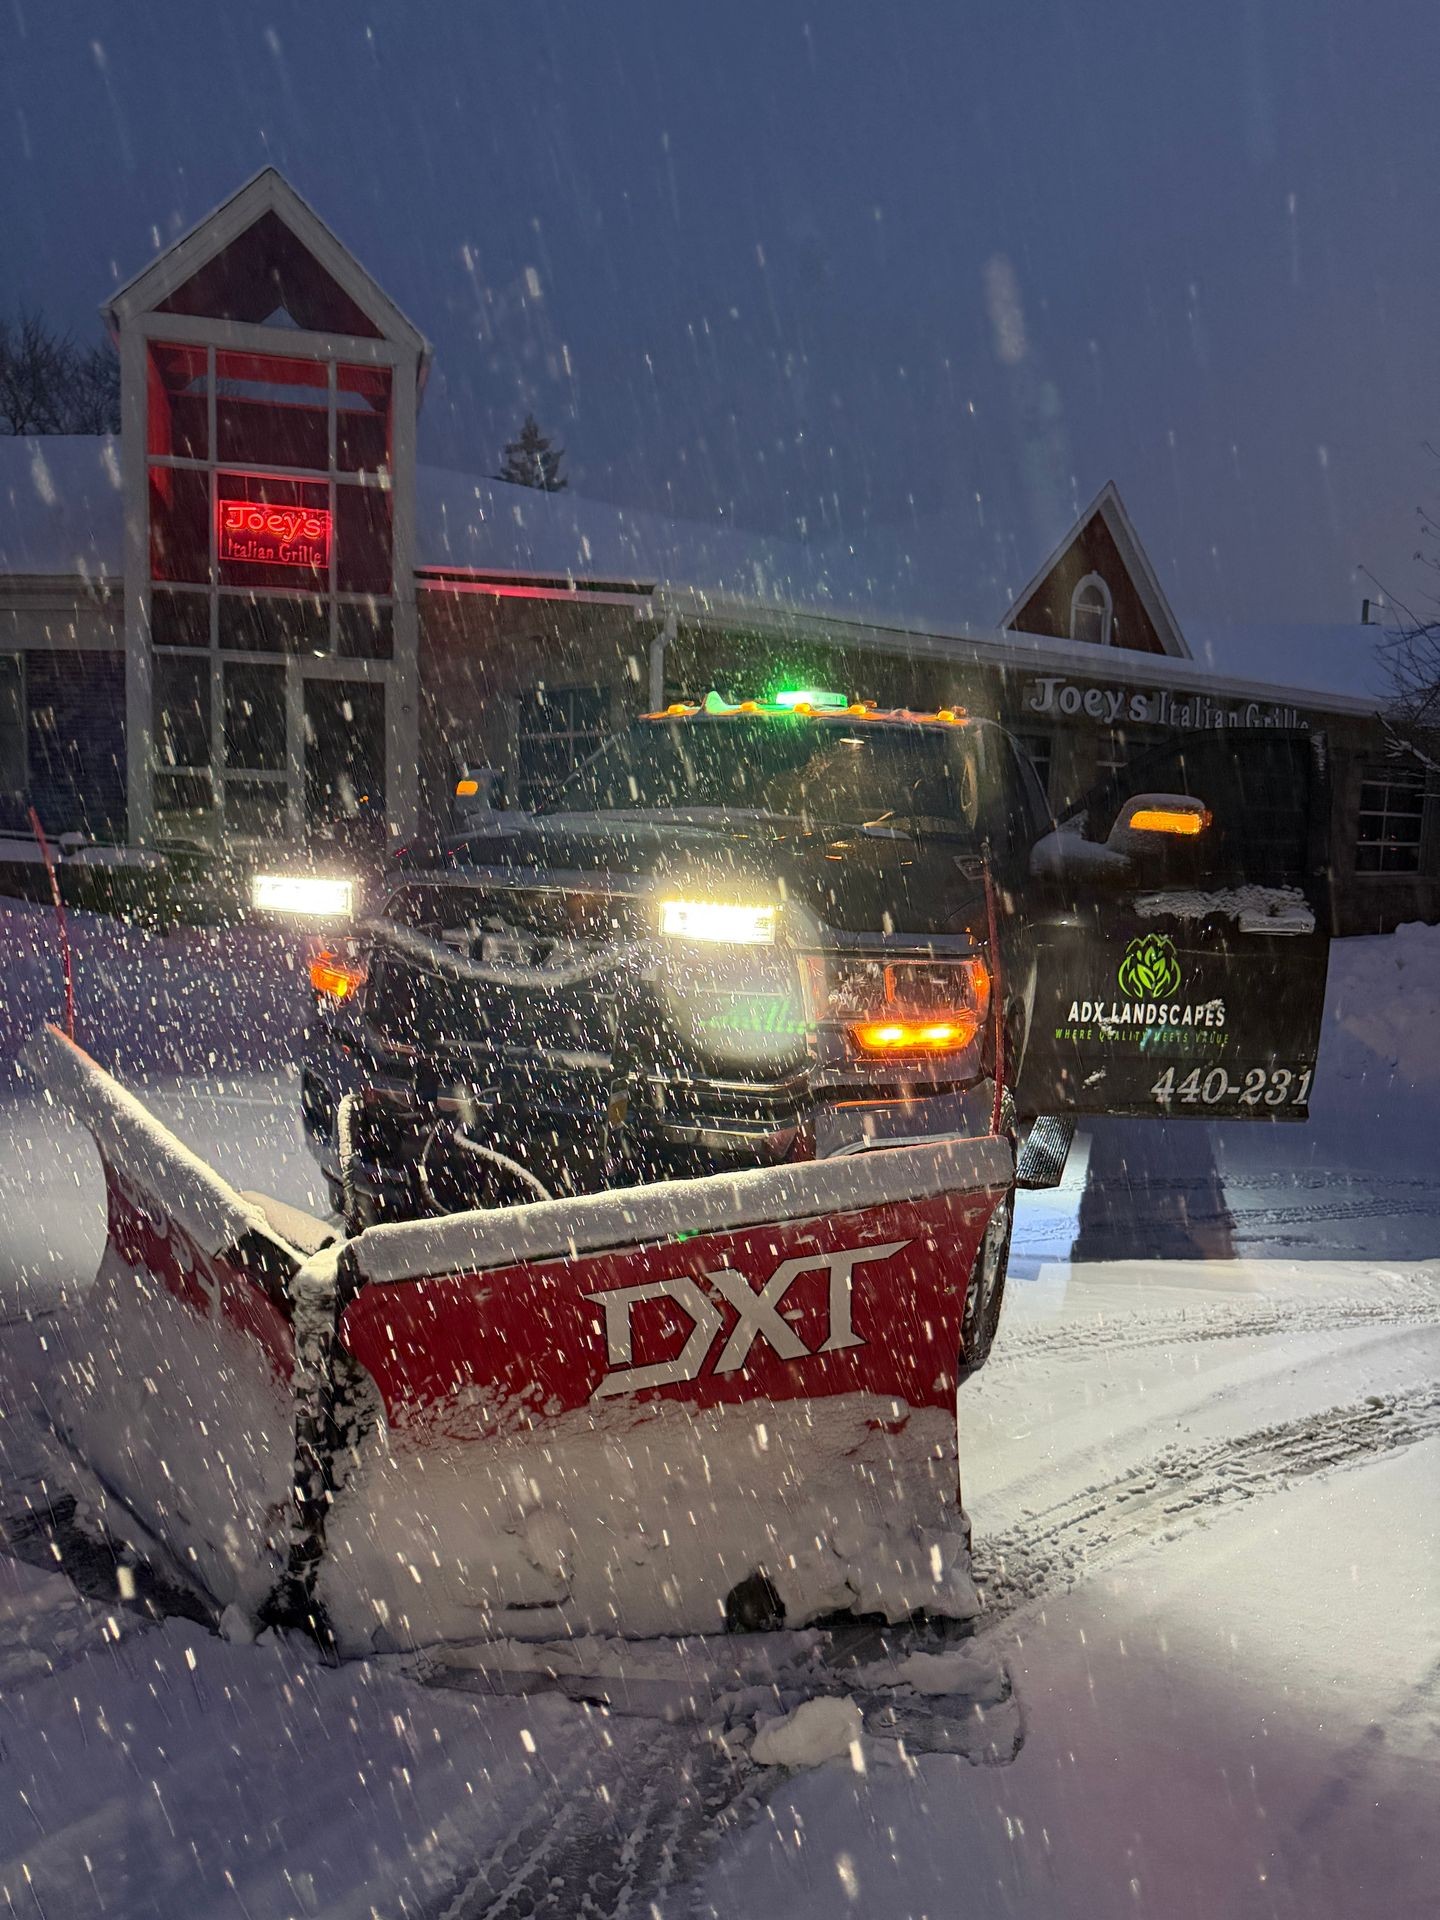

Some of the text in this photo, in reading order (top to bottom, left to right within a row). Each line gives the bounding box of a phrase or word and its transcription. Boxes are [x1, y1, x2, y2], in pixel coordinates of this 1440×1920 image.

[226, 506, 321, 540] Joey's
[228, 538, 321, 564] Italian Grille
[1157, 691, 1239, 728] Italian
[1068, 1001, 1226, 1027] ADX LANDSCAPES
[1055, 1028, 1093, 1040] WHERE
[1151, 1065, 1313, 1106] 440-231
[584, 1238, 913, 1399] DXT
